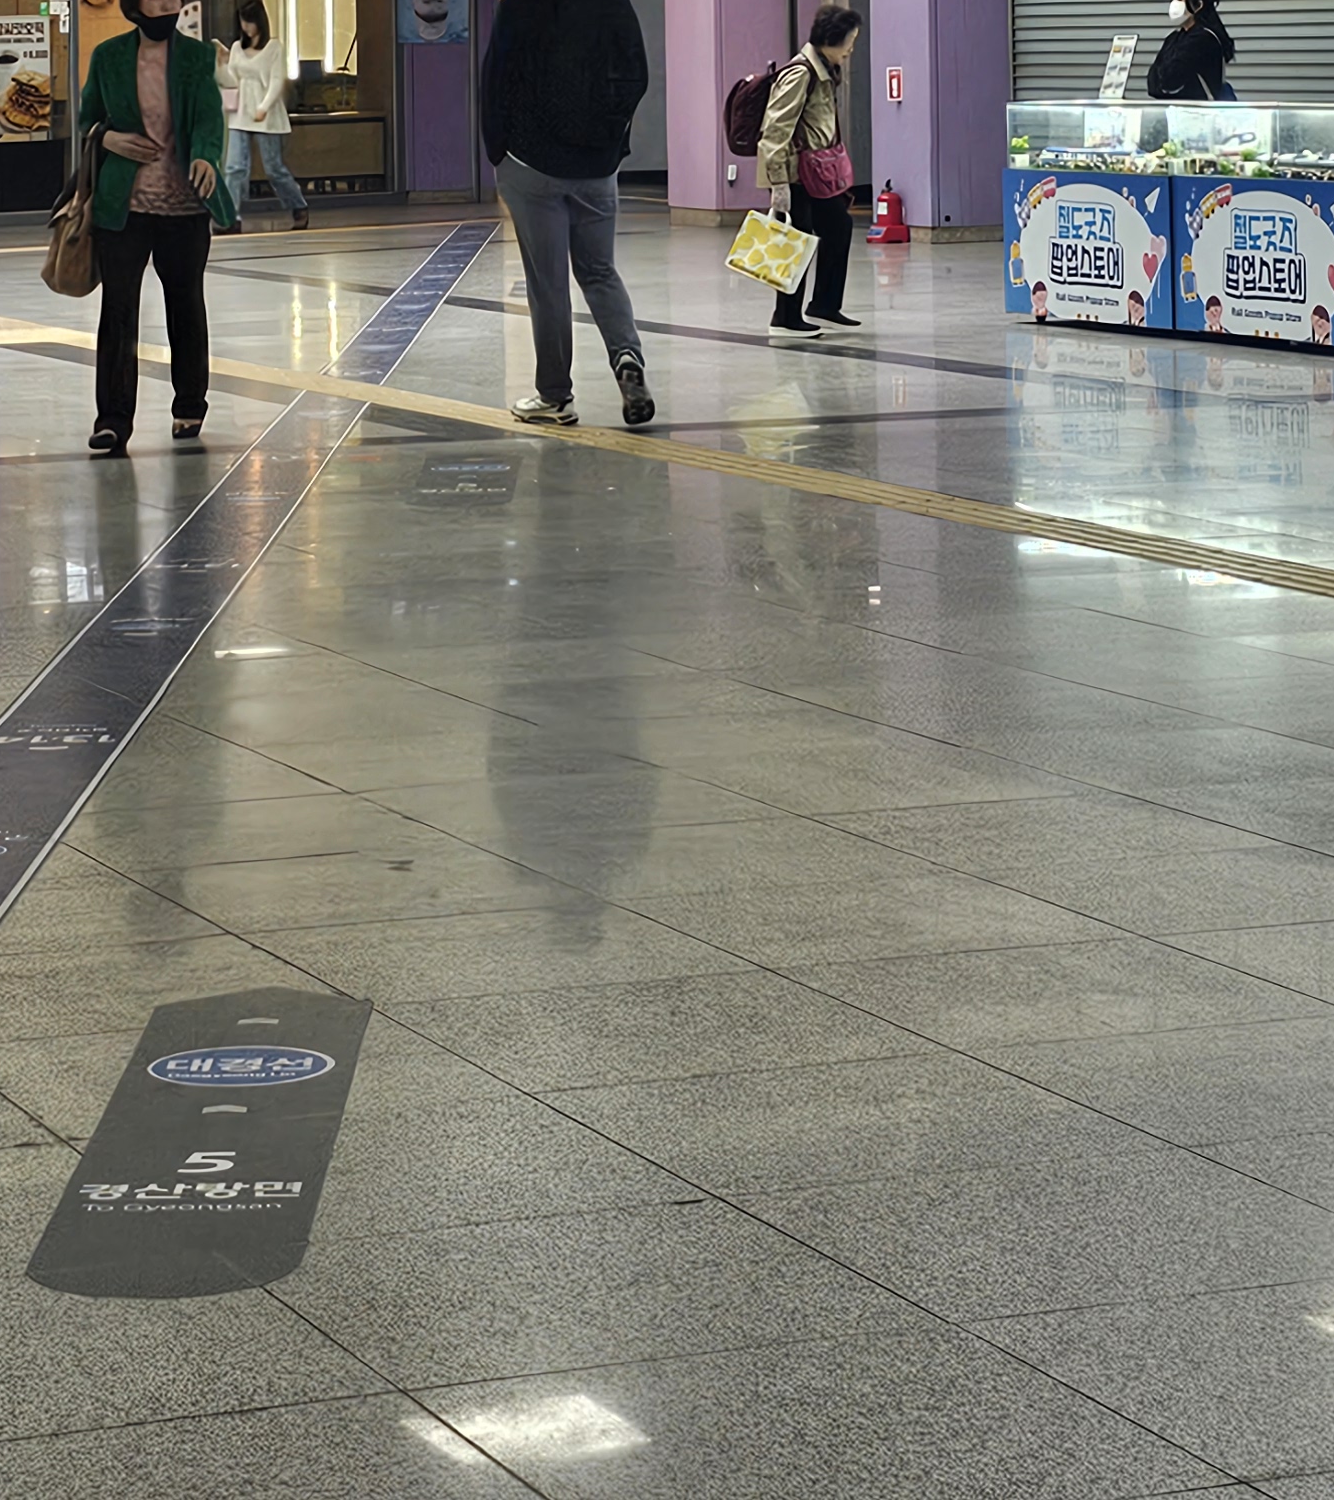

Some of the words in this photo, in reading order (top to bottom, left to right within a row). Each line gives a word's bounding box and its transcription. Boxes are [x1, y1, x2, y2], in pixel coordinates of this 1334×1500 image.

[1058, 205, 1113, 242] 철도굿즈
[1234, 213, 1293, 253] 철도굿즈
[1051, 242, 1120, 282] 팝업스토어
[1226, 253, 1302, 296] 팝업스토어
[166, 1056, 315, 1072] 대경선
[177, 1151, 237, 1173] 5
[79, 1181, 303, 1201] 경산방면
[82, 1203, 114, 1212] To
[123, 1202, 283, 1213] Gyeongsan
